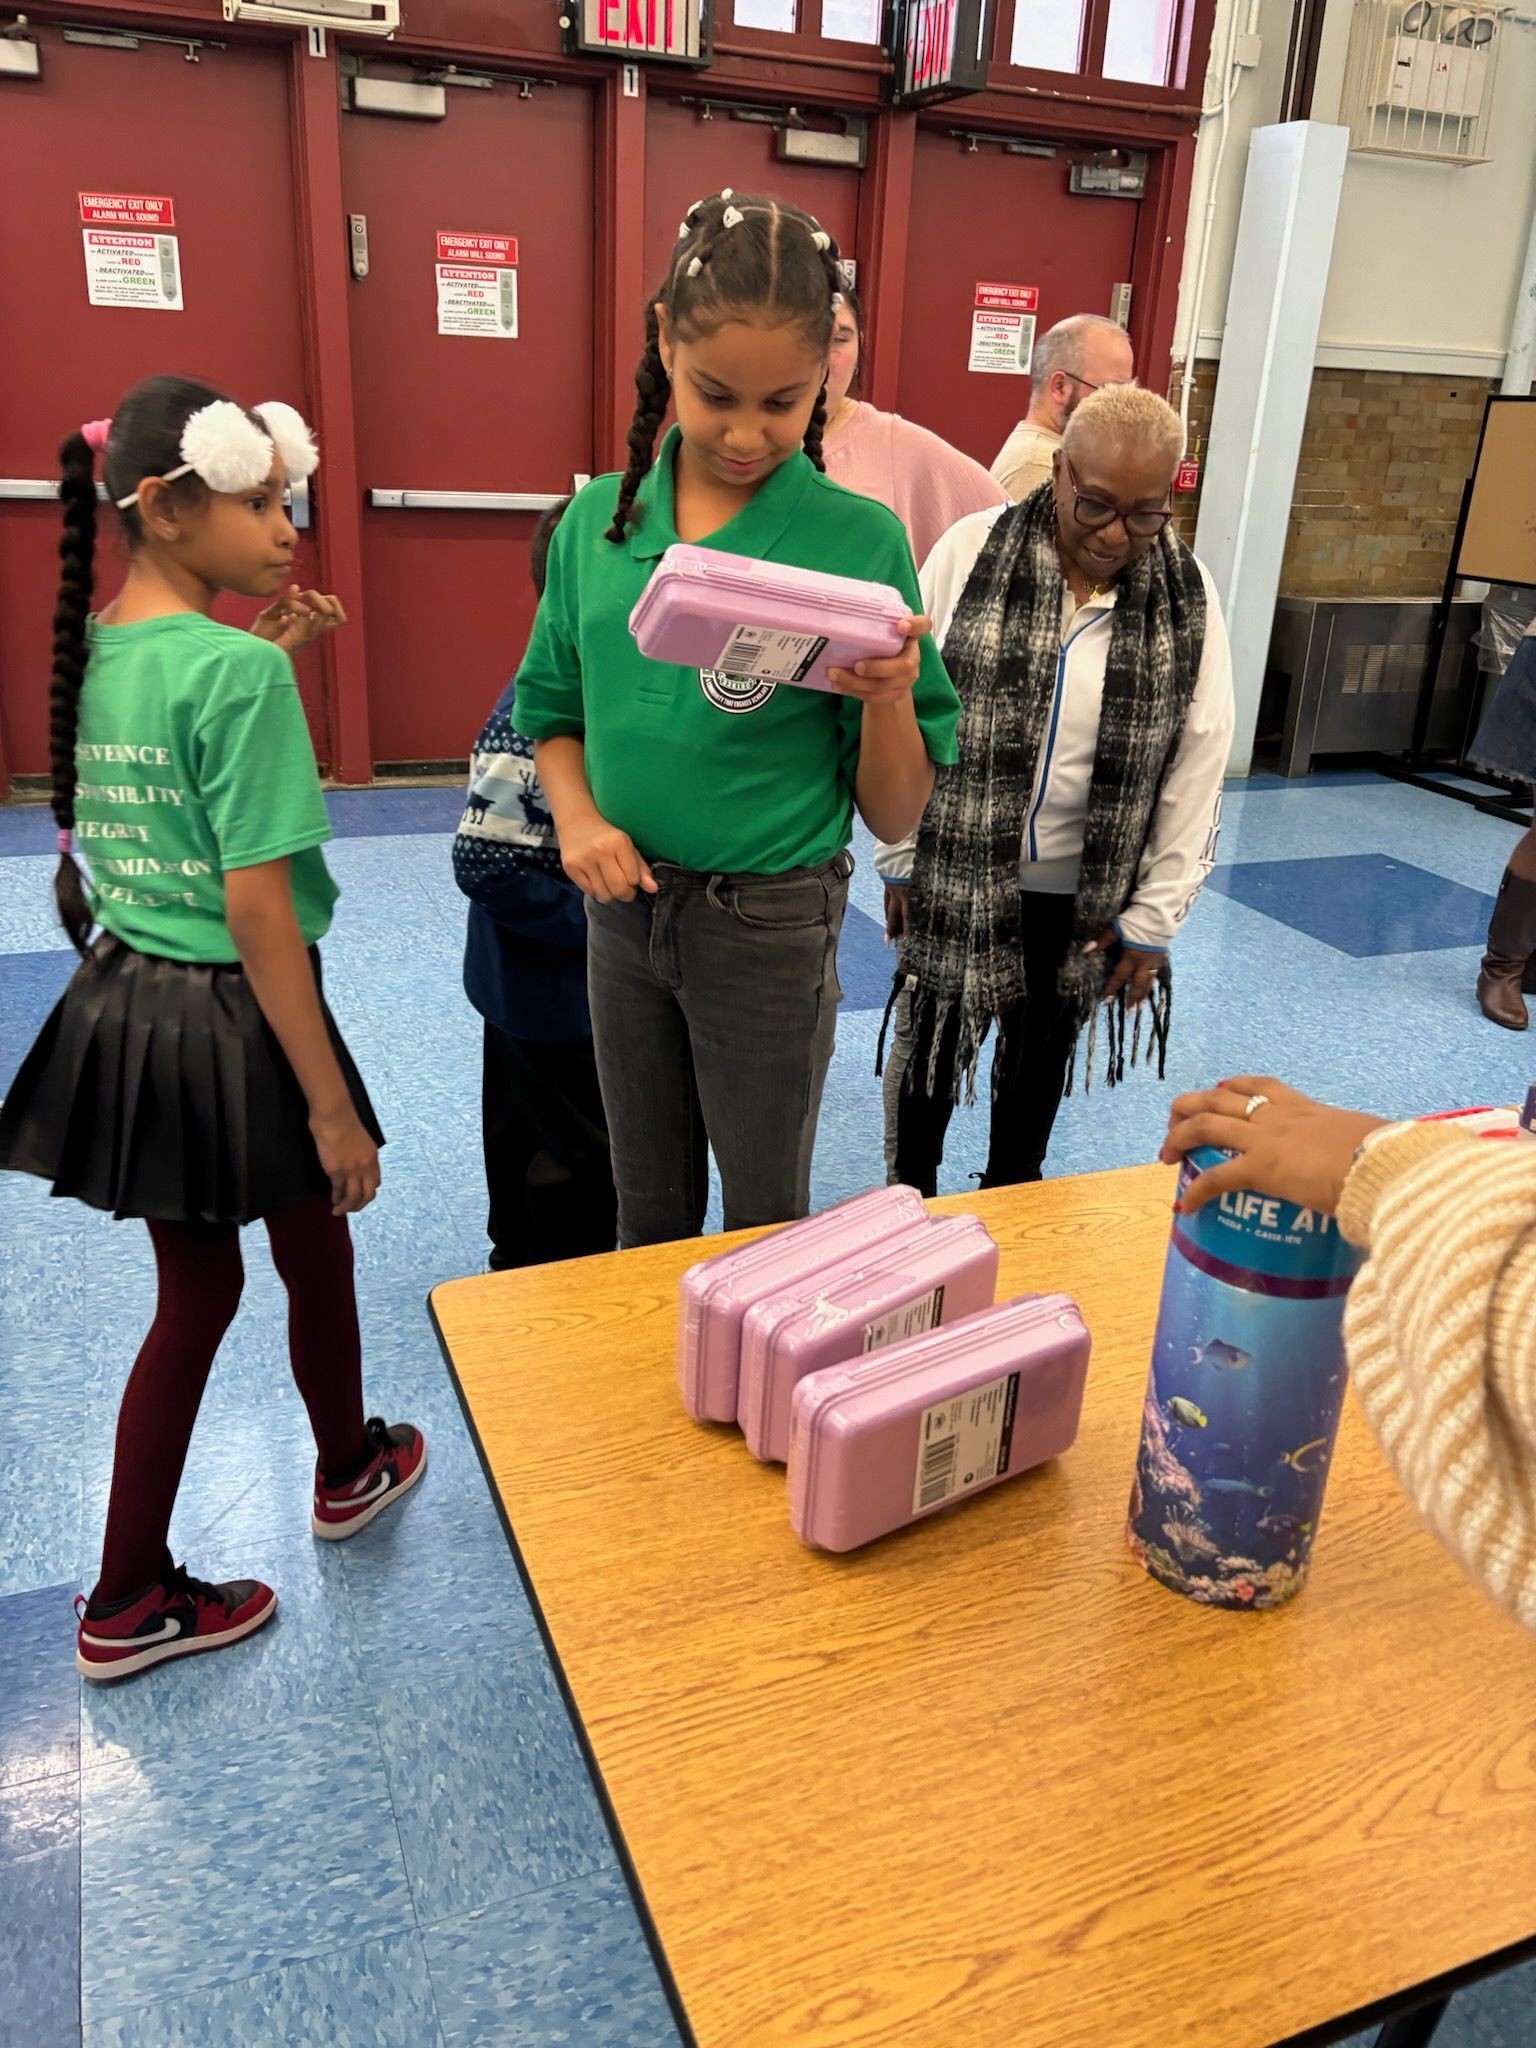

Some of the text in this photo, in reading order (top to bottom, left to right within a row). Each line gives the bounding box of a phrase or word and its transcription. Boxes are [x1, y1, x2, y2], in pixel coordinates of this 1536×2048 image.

[312, 27, 320, 53] 1
[627, 68, 634, 93] 1
[83, 197, 163, 211] EMERGENCY EXIT ONLY
[92, 210, 159, 222] ALARM WILL SOUND
[91, 235, 152, 247] ATTENTION
[441, 236, 509, 250] EMERGENCY EXIT ONLY
[97, 248, 134, 256] ACTIVATED
[448, 249, 469, 257] ALARM
[121, 257, 141, 265] RED
[99, 267, 145, 275] DEACTIVATED
[442, 269, 495, 280] ATTENTION
[122, 276, 156, 285] GREEN
[448, 299, 488, 307] DEACTIVATED
[467, 307, 496, 316] GREEN
[978, 315, 1019, 325] ATTENTION
[1219, 1191, 1281, 1228] LIFE
